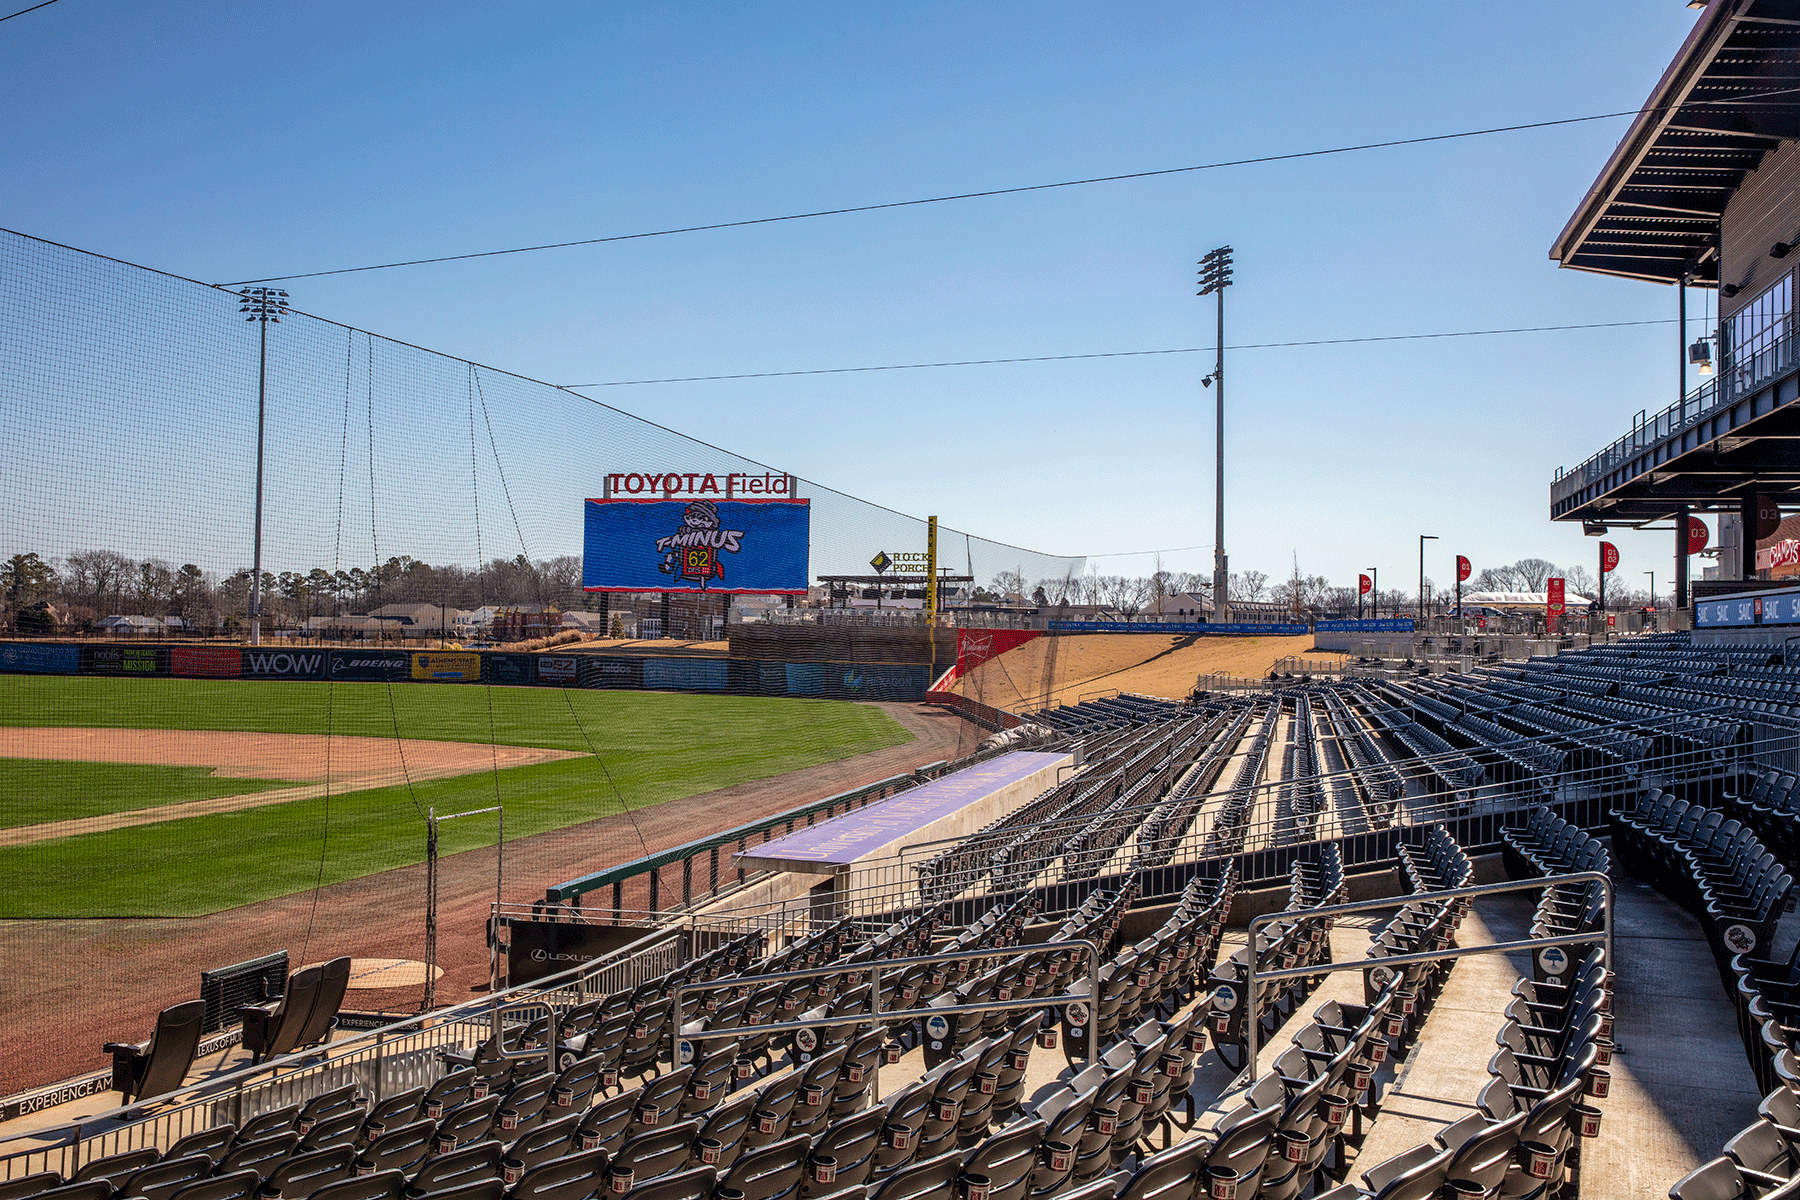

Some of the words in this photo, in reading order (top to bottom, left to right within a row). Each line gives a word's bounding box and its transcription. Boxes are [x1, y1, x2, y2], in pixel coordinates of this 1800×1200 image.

[608, 472, 720, 494] TOYOTA
[728, 471, 788, 494] Field
[1760, 508, 1777, 519] 03
[1691, 528, 1707, 538] 03
[656, 530, 744, 552] T-MINUS
[688, 551, 709, 567] 62
[893, 552, 929, 562] ROCK
[1461, 563, 1471, 571] 01
[1738, 602, 1751, 621] SAIC
[1765, 600, 1779, 619] SAIC
[93, 648, 120, 660] noblis
[122, 660, 156, 672] MISSION
[250, 653, 322, 674] WOW!
[349, 659, 405, 668] BOEING
[552, 659, 574, 671] EZ
[602, 662, 632, 674] leidos
[548, 952, 594, 961] LEXUS
[342, 1018, 384, 1028] EXPERIENCE
[198, 1039, 220, 1057] LEXUS
[220, 1036, 230, 1048] OF
[20, 1081, 94, 1116] EXPERIENCE
